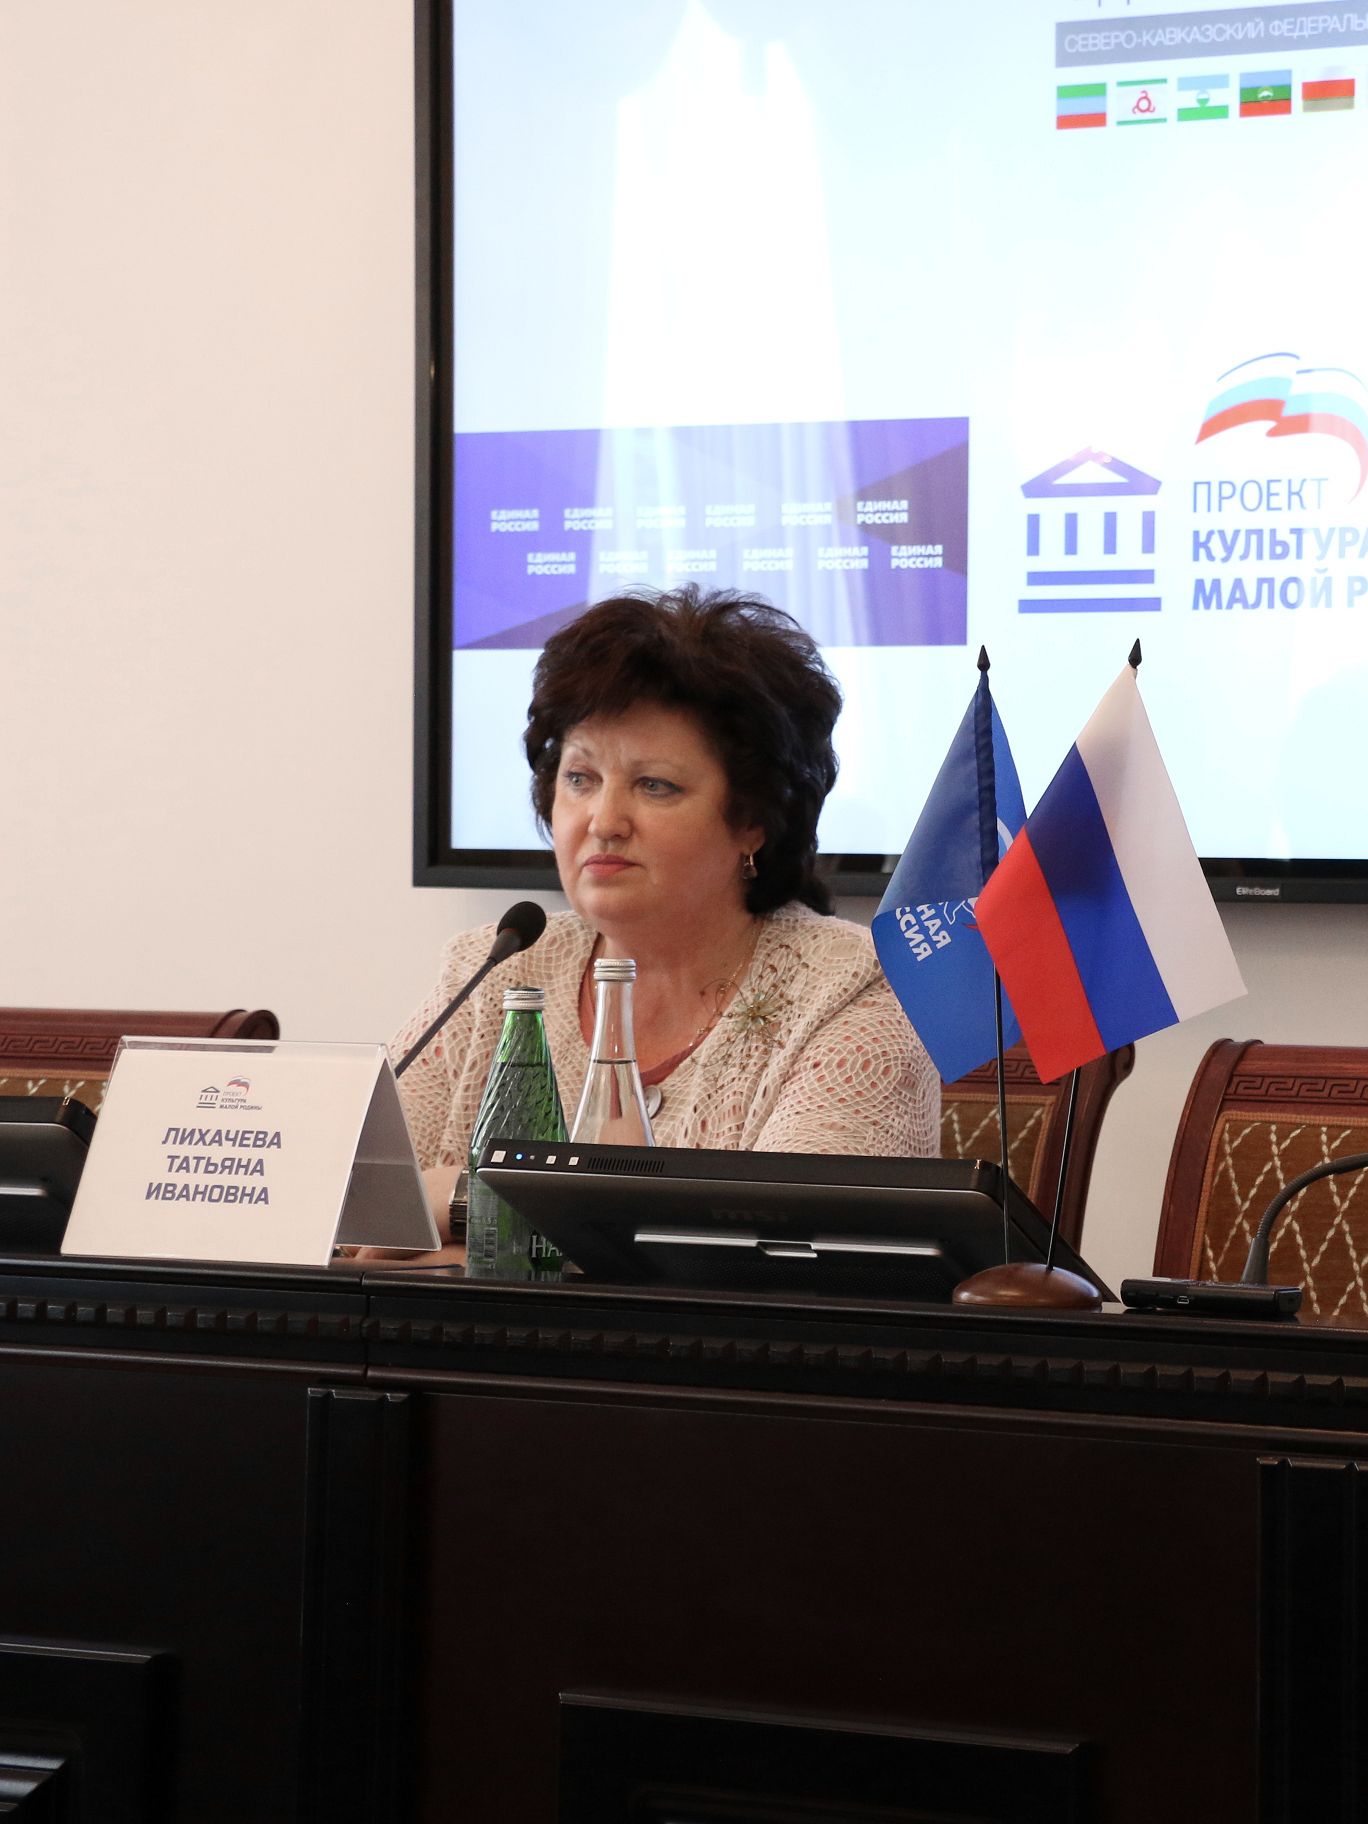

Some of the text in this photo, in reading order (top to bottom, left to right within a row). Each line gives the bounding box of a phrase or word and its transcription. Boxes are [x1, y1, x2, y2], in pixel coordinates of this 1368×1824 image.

[1064, 18, 1264, 52] СЕВЕРО-КАВКАЗСКИЙ
[1193, 478, 1328, 513] ПРОЕКТ
[857, 500, 908, 512] ЕДИНАЯ
[490, 509, 539, 521] ЕДИНАЯ
[857, 512, 908, 524] РОССИЯ
[490, 520, 539, 532] РОССИЯ
[817, 546, 868, 558] ЕДИНАЯ
[891, 545, 943, 557] ЕДИНАЯ
[527, 552, 576, 564] ЕДИНАЯ
[817, 558, 868, 570] РОССИЯ
[891, 556, 943, 568] РОССИЯ
[527, 563, 576, 575] РОССИЯ
[1192, 568, 1332, 610] МАЛОЙ
[162, 1128, 282, 1149] ЛИХАЧЕВА
[167, 1156, 264, 1176] ТАТЬЯНА
[145, 1182, 269, 1205] ИВАНОВНА
